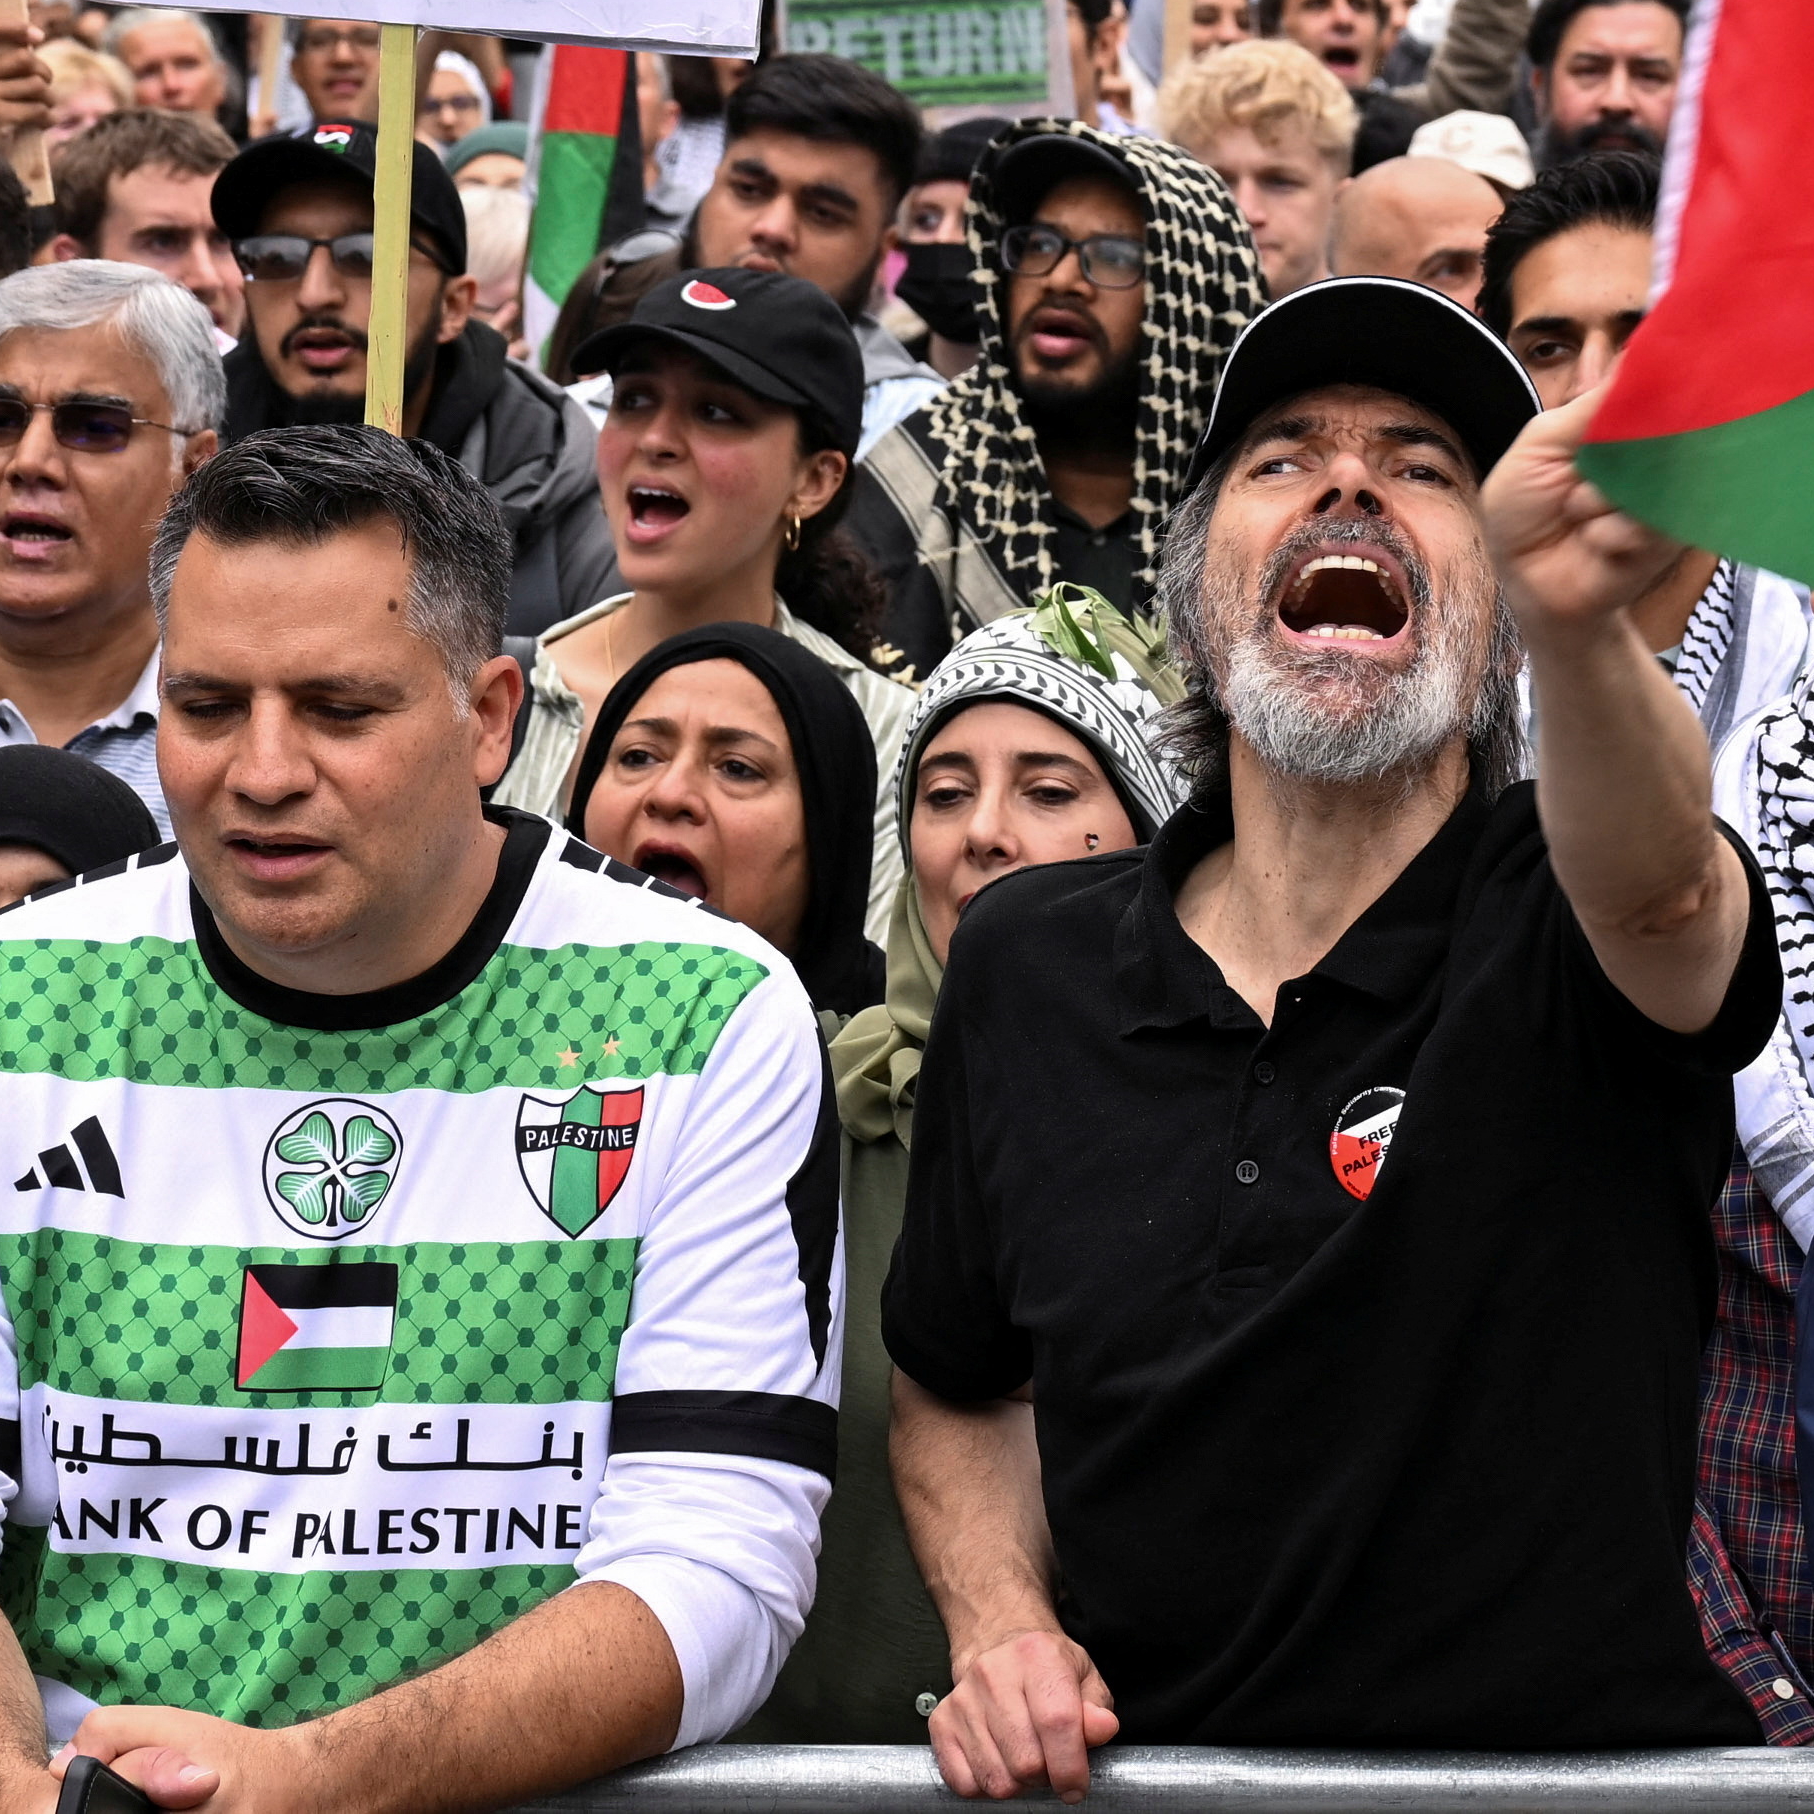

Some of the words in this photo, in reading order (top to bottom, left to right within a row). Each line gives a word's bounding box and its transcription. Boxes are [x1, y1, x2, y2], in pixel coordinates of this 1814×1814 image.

[788, 4, 1049, 81] RETURN
[524, 1123, 634, 1151] PALESTINE
[42, 1404, 359, 1476] فلسطين
[377, 1417, 584, 1482] بنك
[186, 1502, 268, 1555] OF
[291, 1502, 583, 1560] PALESTINE
